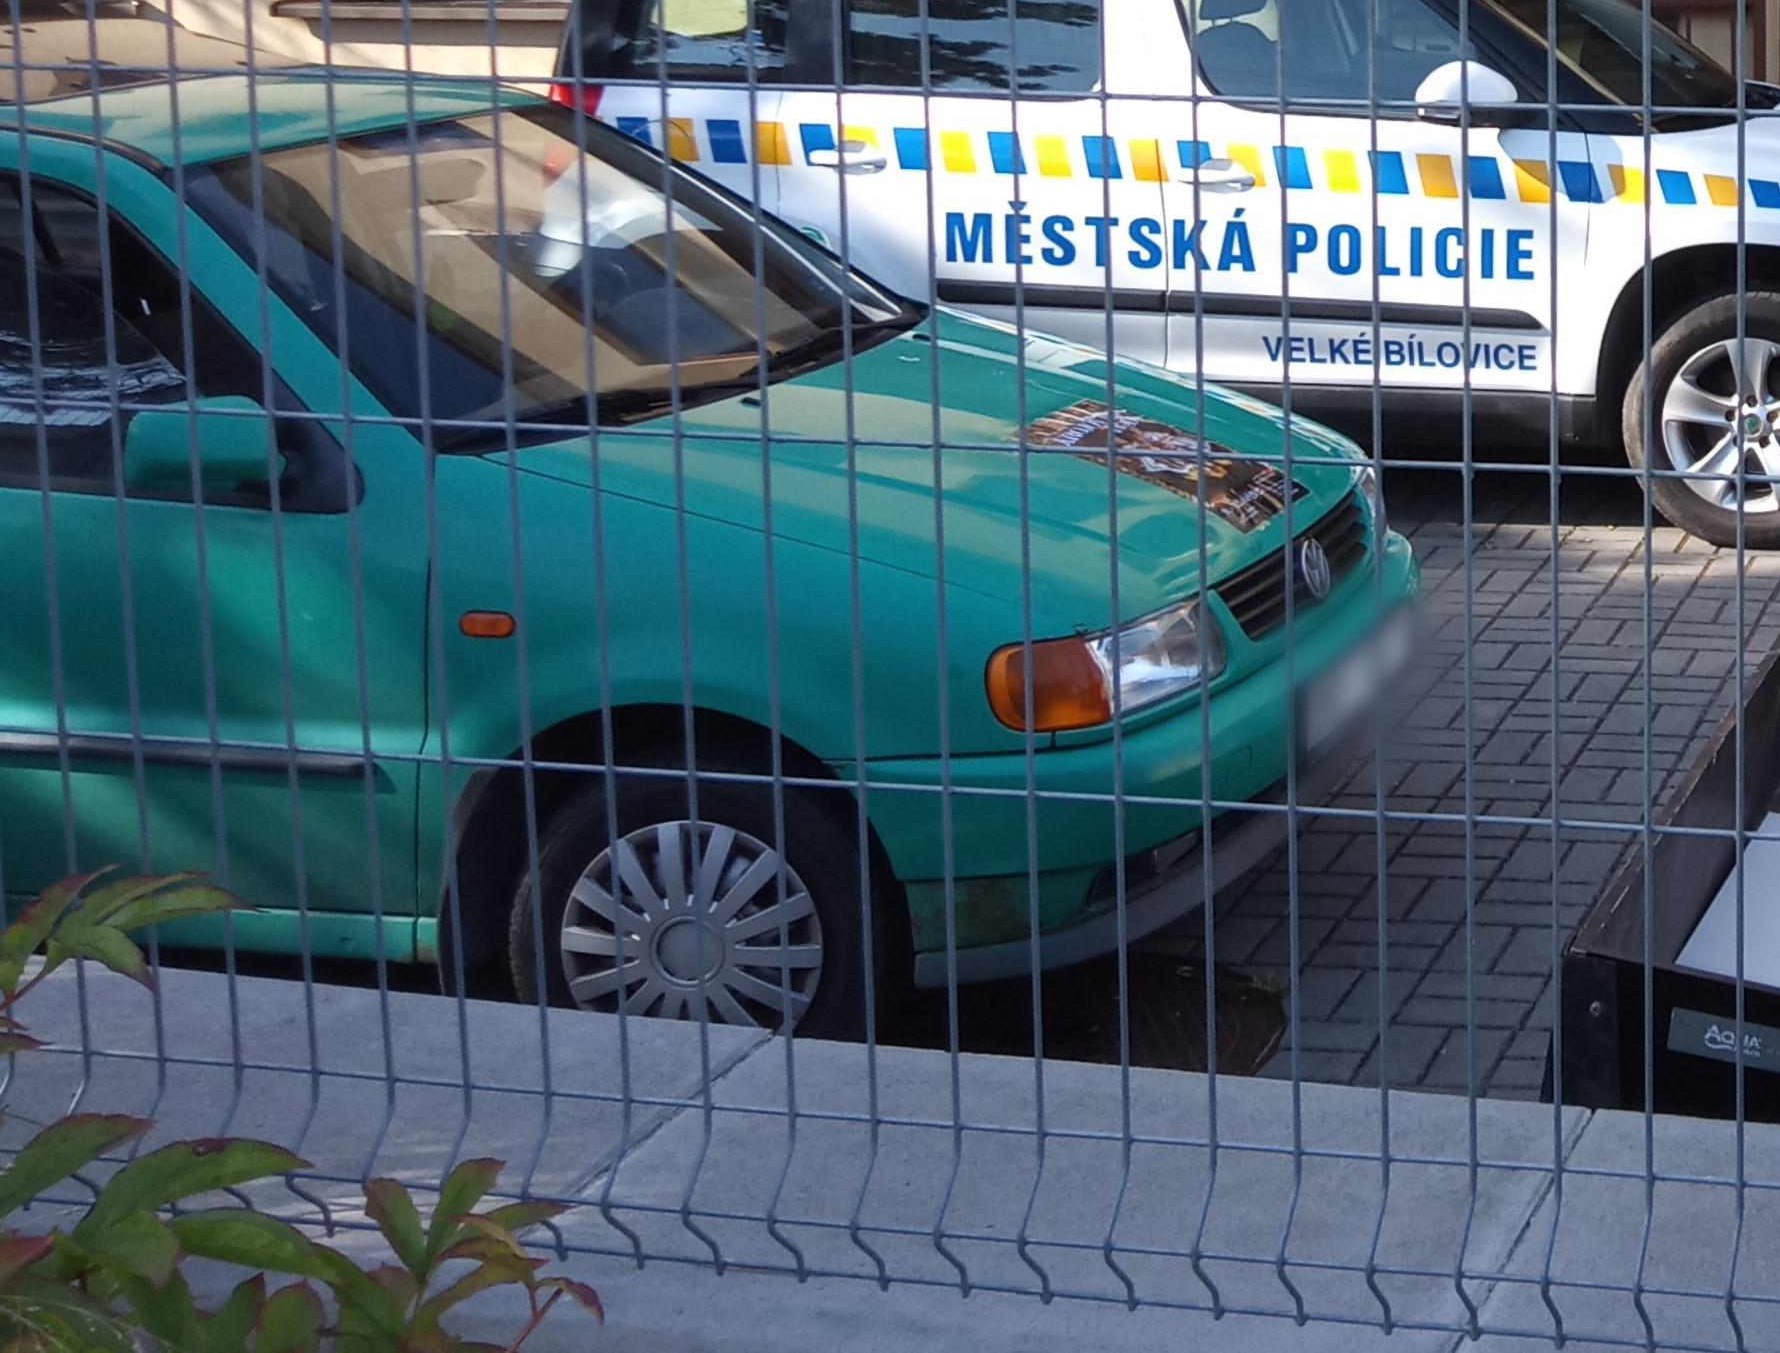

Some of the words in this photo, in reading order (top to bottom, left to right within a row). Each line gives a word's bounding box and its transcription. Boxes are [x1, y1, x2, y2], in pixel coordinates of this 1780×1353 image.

[945, 200, 1256, 272] MĚSTSKÁ
[1284, 222, 1535, 280] POLICIE
[1261, 331, 1374, 365] VELKÉ
[1383, 333, 1538, 371] BÍLOVICE
